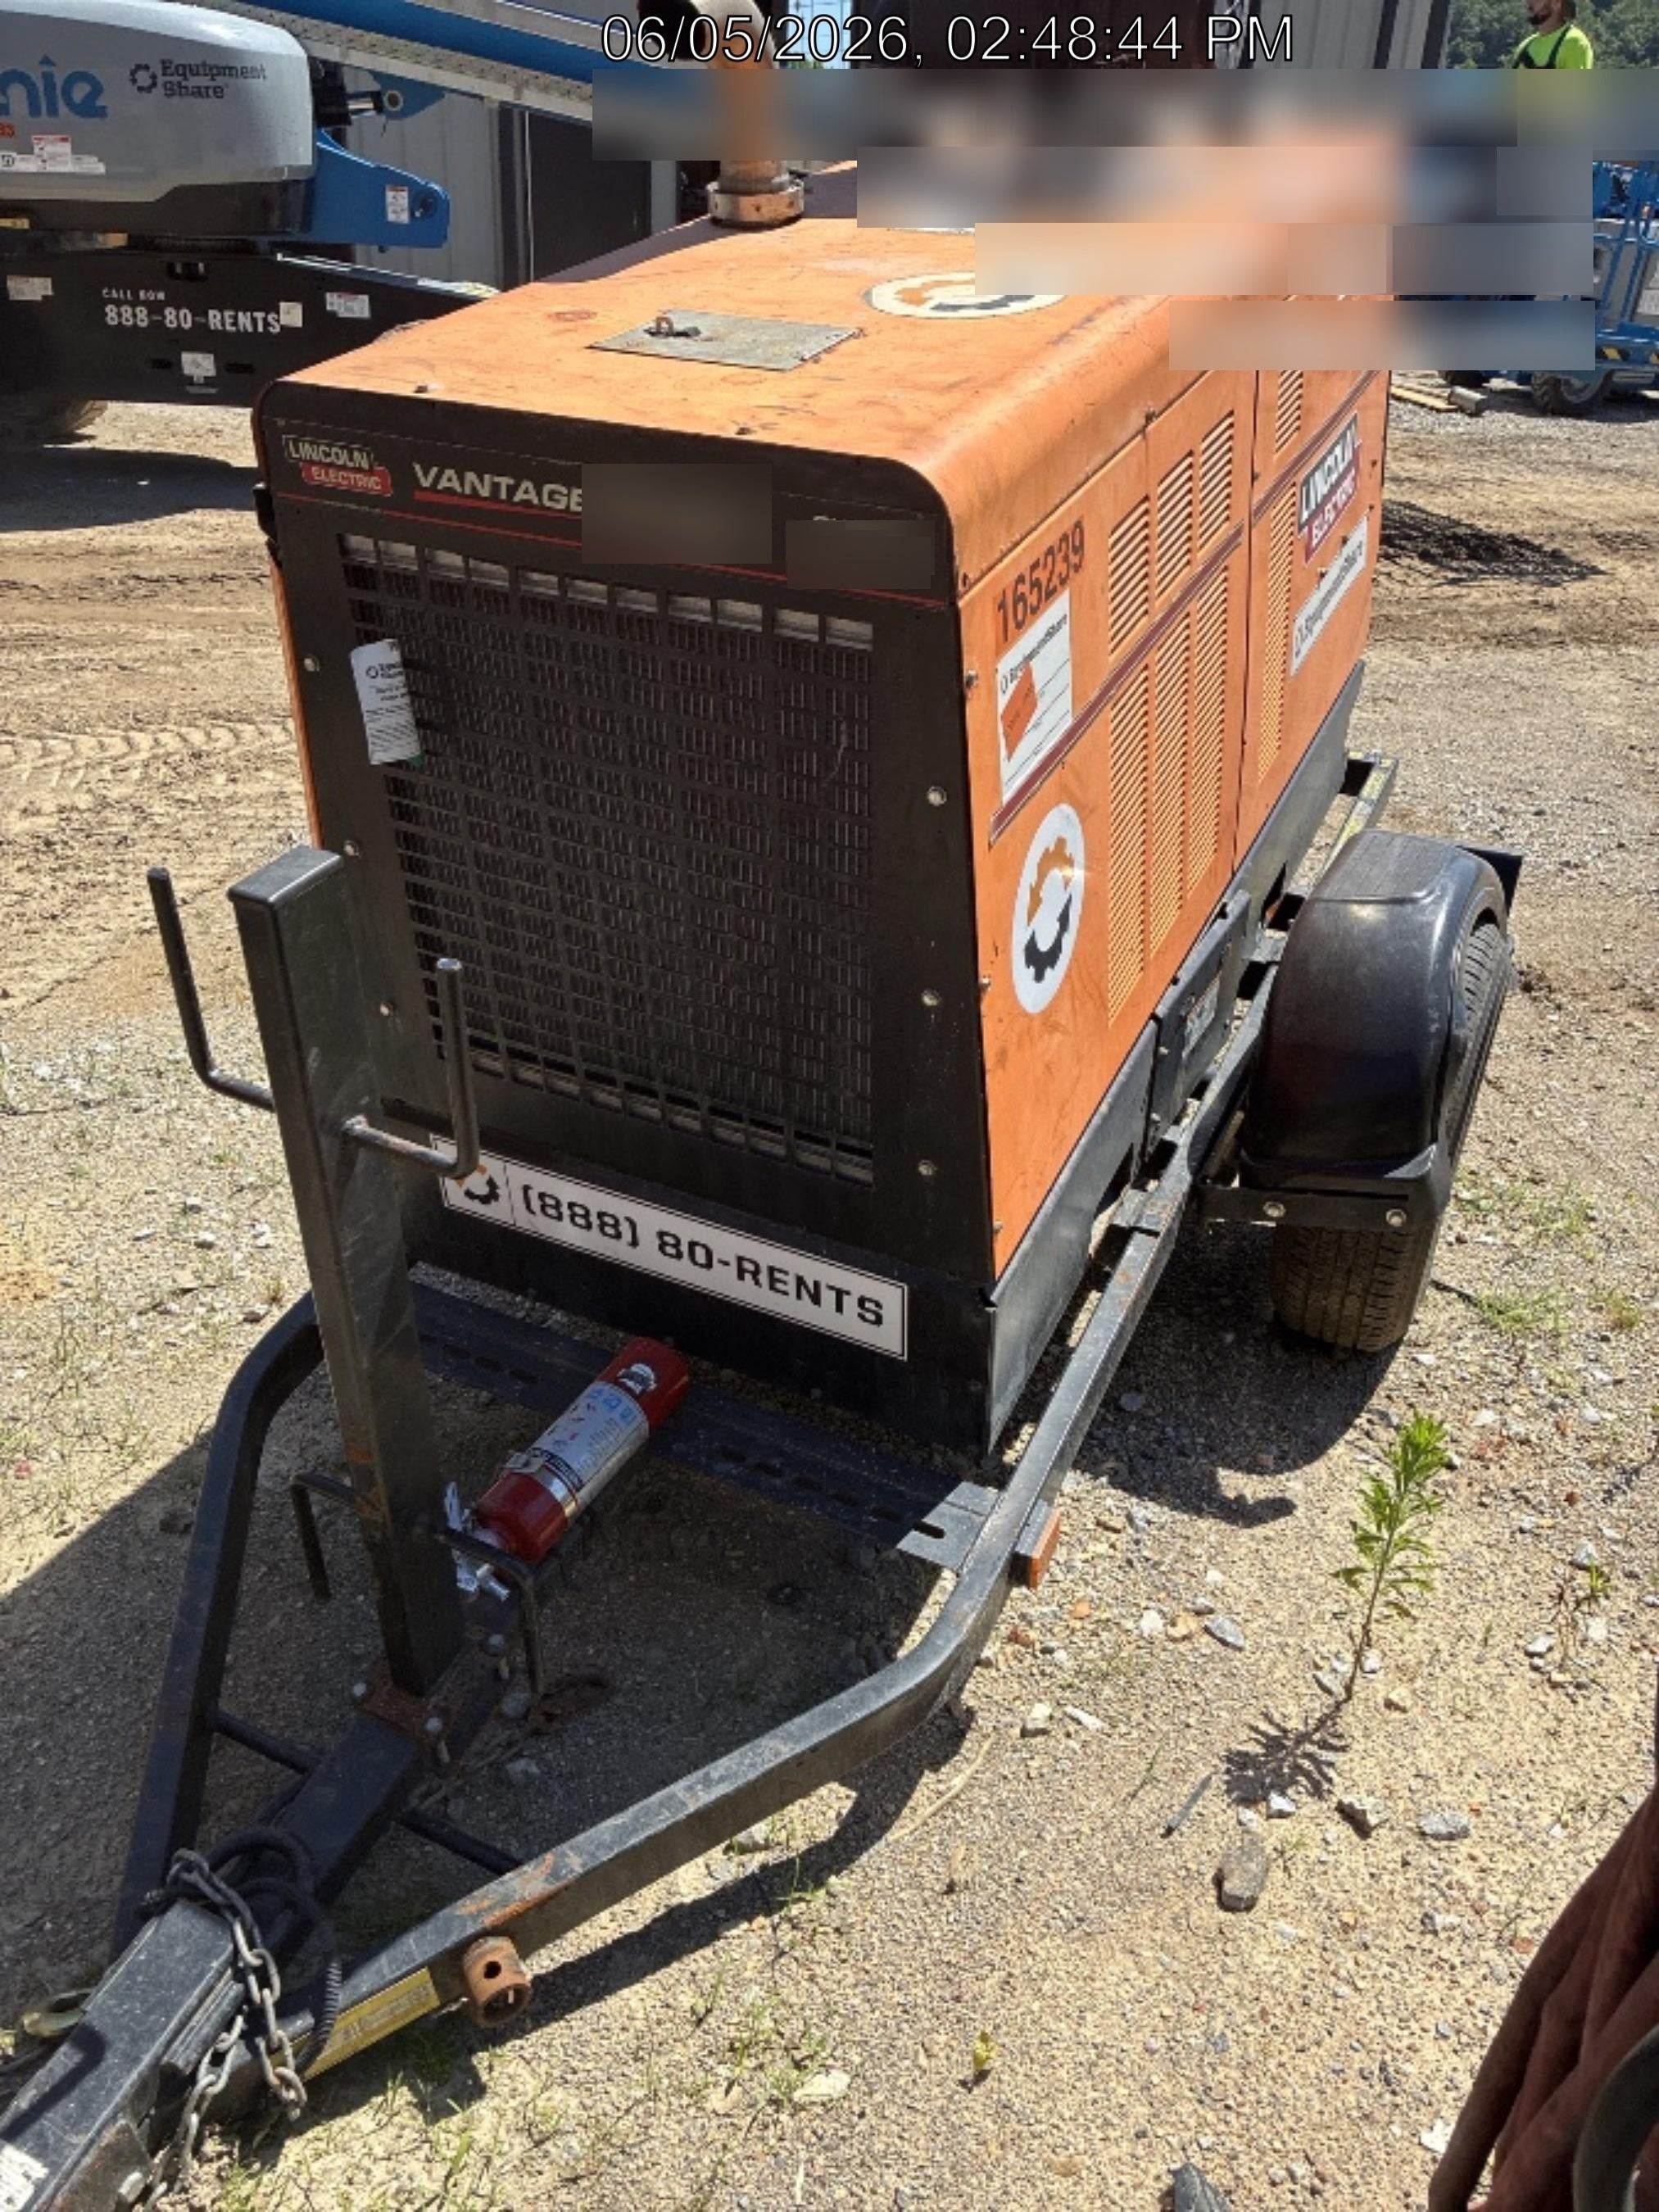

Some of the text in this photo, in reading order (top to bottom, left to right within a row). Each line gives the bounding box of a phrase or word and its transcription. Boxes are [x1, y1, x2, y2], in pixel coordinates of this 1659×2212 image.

[0, 54, 107, 118] nie
[160, 59, 267, 83] Equipment
[163, 81, 225, 99] Share
[102, 288, 134, 301] CALL
[104, 303, 282, 334] 888-80-RENTS
[288, 438, 370, 469] LINCOLN
[310, 465, 382, 491] ELECTRIC
[996, 519, 1086, 643] 165239
[521, 1182, 884, 1328] (888) 80-RENTS
